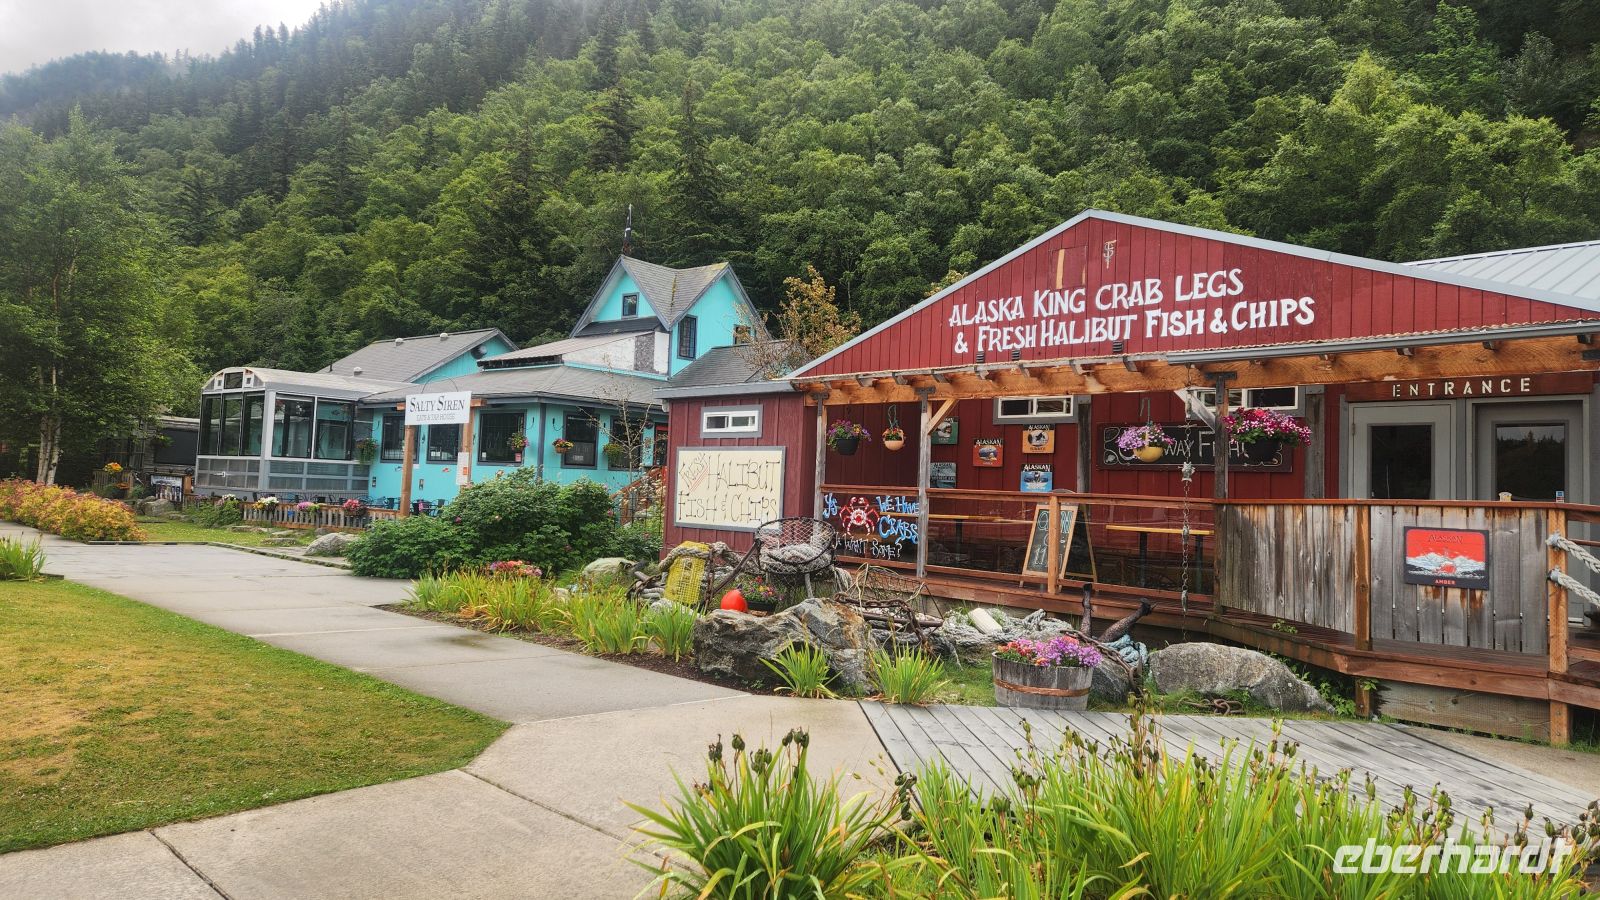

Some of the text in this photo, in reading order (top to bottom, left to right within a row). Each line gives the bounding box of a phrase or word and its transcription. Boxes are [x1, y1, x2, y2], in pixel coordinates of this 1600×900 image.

[949, 268, 1243, 327] ALASKA KING CRAB LEGS
[954, 296, 1315, 353] & FRESH HALIBUT FISH & CHIPS
[1392, 377, 1530, 397] ENTRANCE
[409, 395, 465, 412] SALTY SIREN
[1198, 430, 1239, 458] FIH
[708, 454, 780, 492] HALIBUT
[678, 491, 717, 521] FISH
